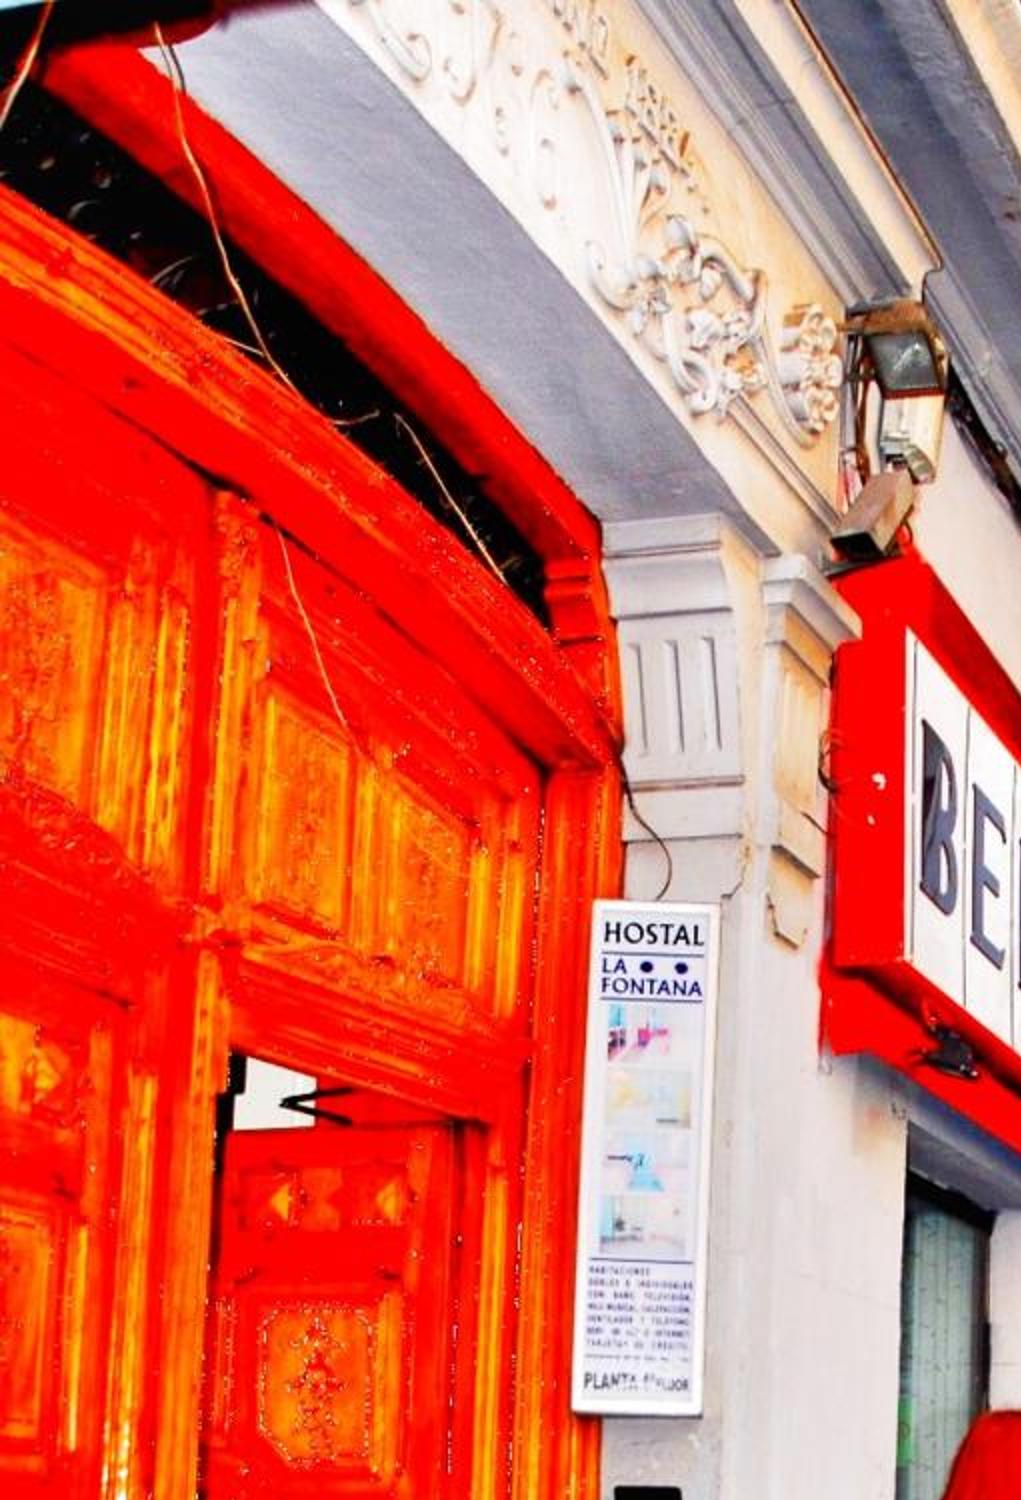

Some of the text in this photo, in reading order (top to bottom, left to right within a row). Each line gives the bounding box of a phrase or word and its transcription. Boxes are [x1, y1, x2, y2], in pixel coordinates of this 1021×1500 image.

[604, 921, 705, 946] HOSTAL
[602, 957, 627, 974] LA
[601, 977, 703, 996] FONTANA
